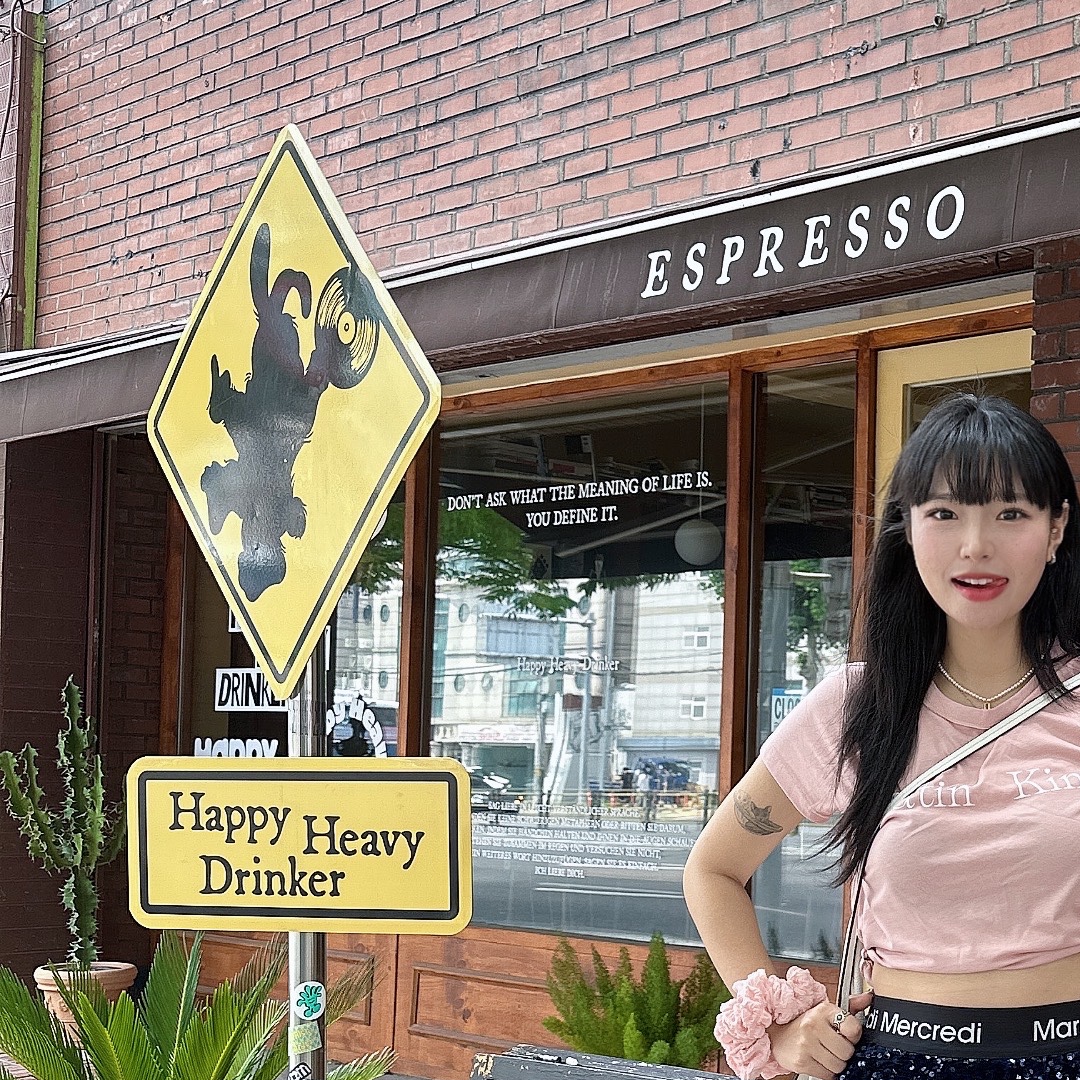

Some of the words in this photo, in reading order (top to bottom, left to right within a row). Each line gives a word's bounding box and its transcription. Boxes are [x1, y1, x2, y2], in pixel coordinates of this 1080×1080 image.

[641, 185, 965, 298] ESPRESSO
[447, 494, 483, 511] DON'T
[485, 491, 507, 508] ASK
[509, 488, 547, 505] WHAT
[549, 485, 575, 502] THE
[578, 478, 639, 499] MEANING
[641, 476, 660, 493] OF
[661, 473, 693, 491] LIFE
[696, 471, 712, 488] IS.
[526, 511, 551, 528] YOU
[553, 507, 598, 526] DEFINE
[601, 505, 618, 522] IT.
[218, 673, 285, 707] DRINK
[169, 791, 291, 845] Happy
[303, 815, 425, 870] Heavy
[199, 855, 346, 897] Drinker
[880, 1011, 983, 1044] Mercredi
